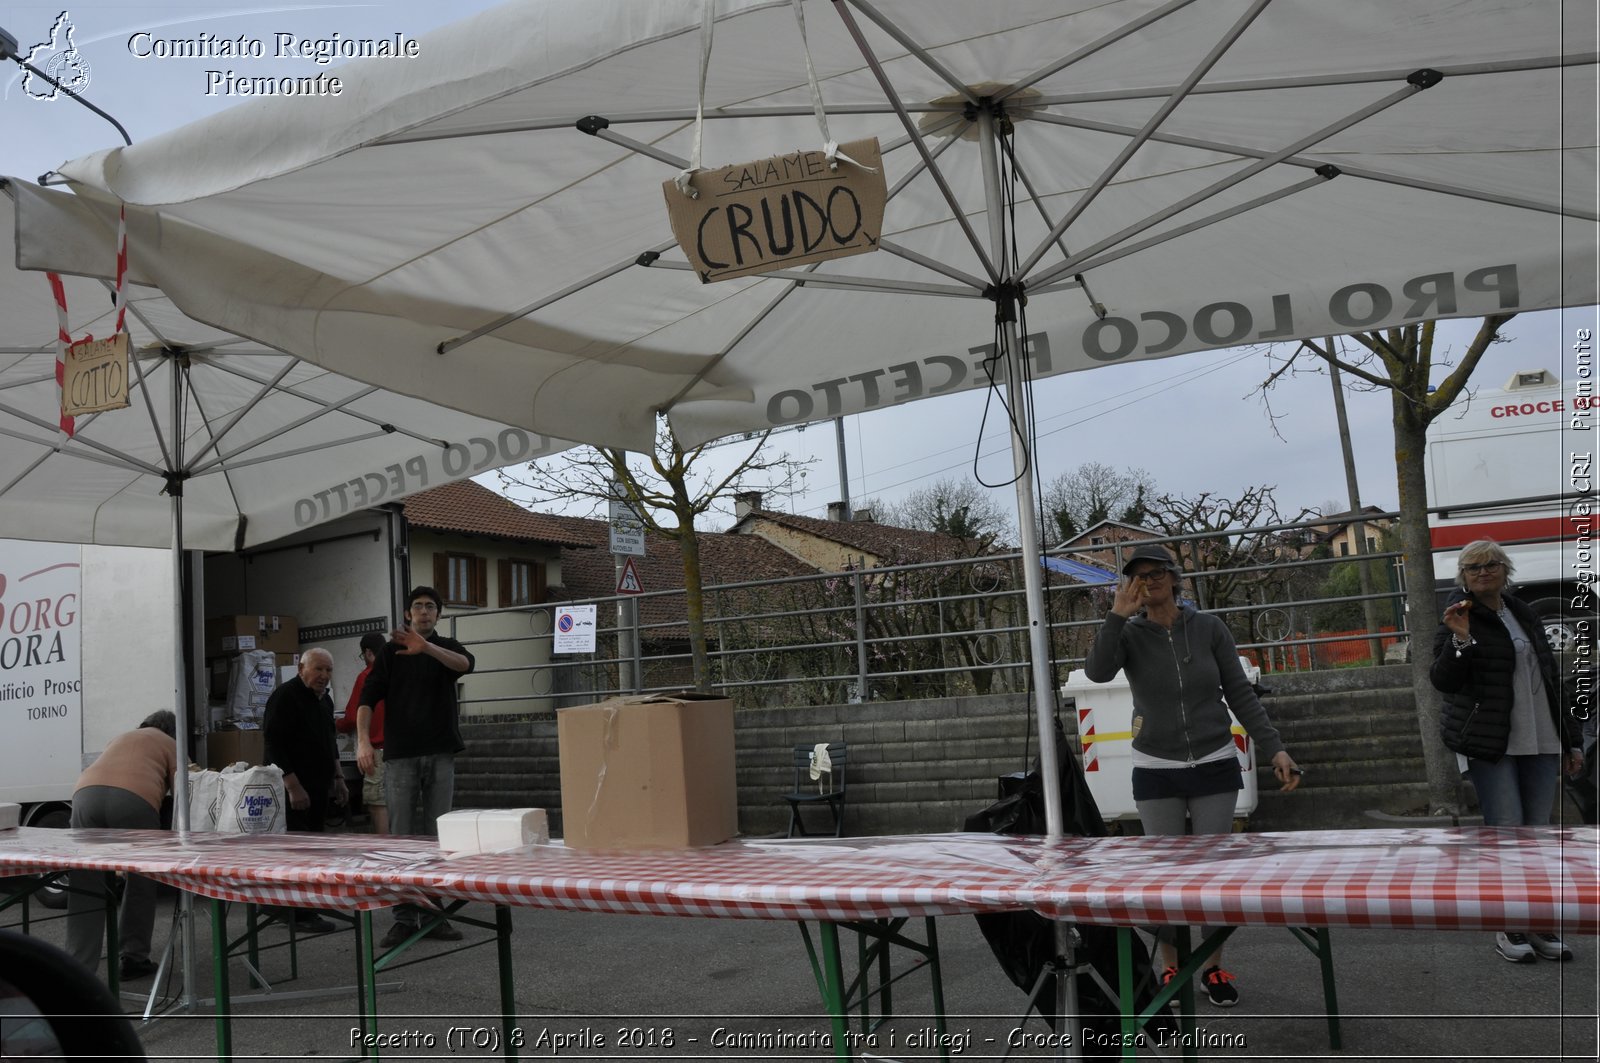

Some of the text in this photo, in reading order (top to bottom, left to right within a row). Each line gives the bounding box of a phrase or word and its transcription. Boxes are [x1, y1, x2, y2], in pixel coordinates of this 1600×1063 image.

[724, 152, 824, 191] SALAME
[697, 185, 862, 270] CRUDO
[71, 361, 122, 407] COTTO
[1490, 400, 1566, 418] CROCE
[0, 631, 66, 670] ORA
[27, 704, 67, 720] TORINO
[240, 796, 272, 809] Molino
[248, 806, 263, 816] Gai
